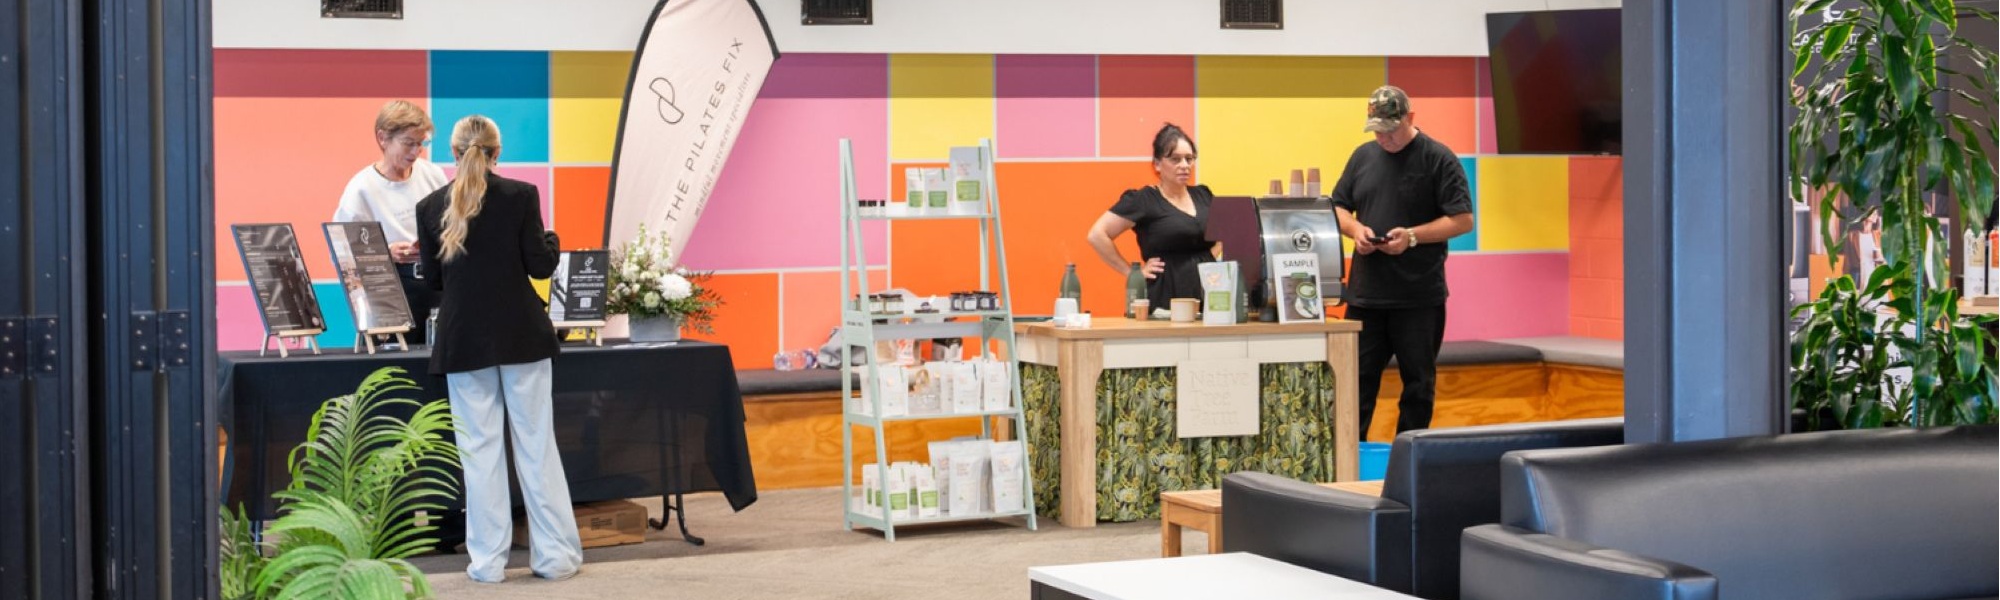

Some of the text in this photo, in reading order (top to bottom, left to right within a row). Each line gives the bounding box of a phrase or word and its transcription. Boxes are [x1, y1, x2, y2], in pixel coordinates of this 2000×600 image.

[665, 37, 743, 222] THE PILATES FIX
[694, 174, 713, 217] mindful
[711, 124, 733, 173] movement
[1282, 260, 1314, 269] SAMPLE
[1189, 369, 1249, 389] Native
